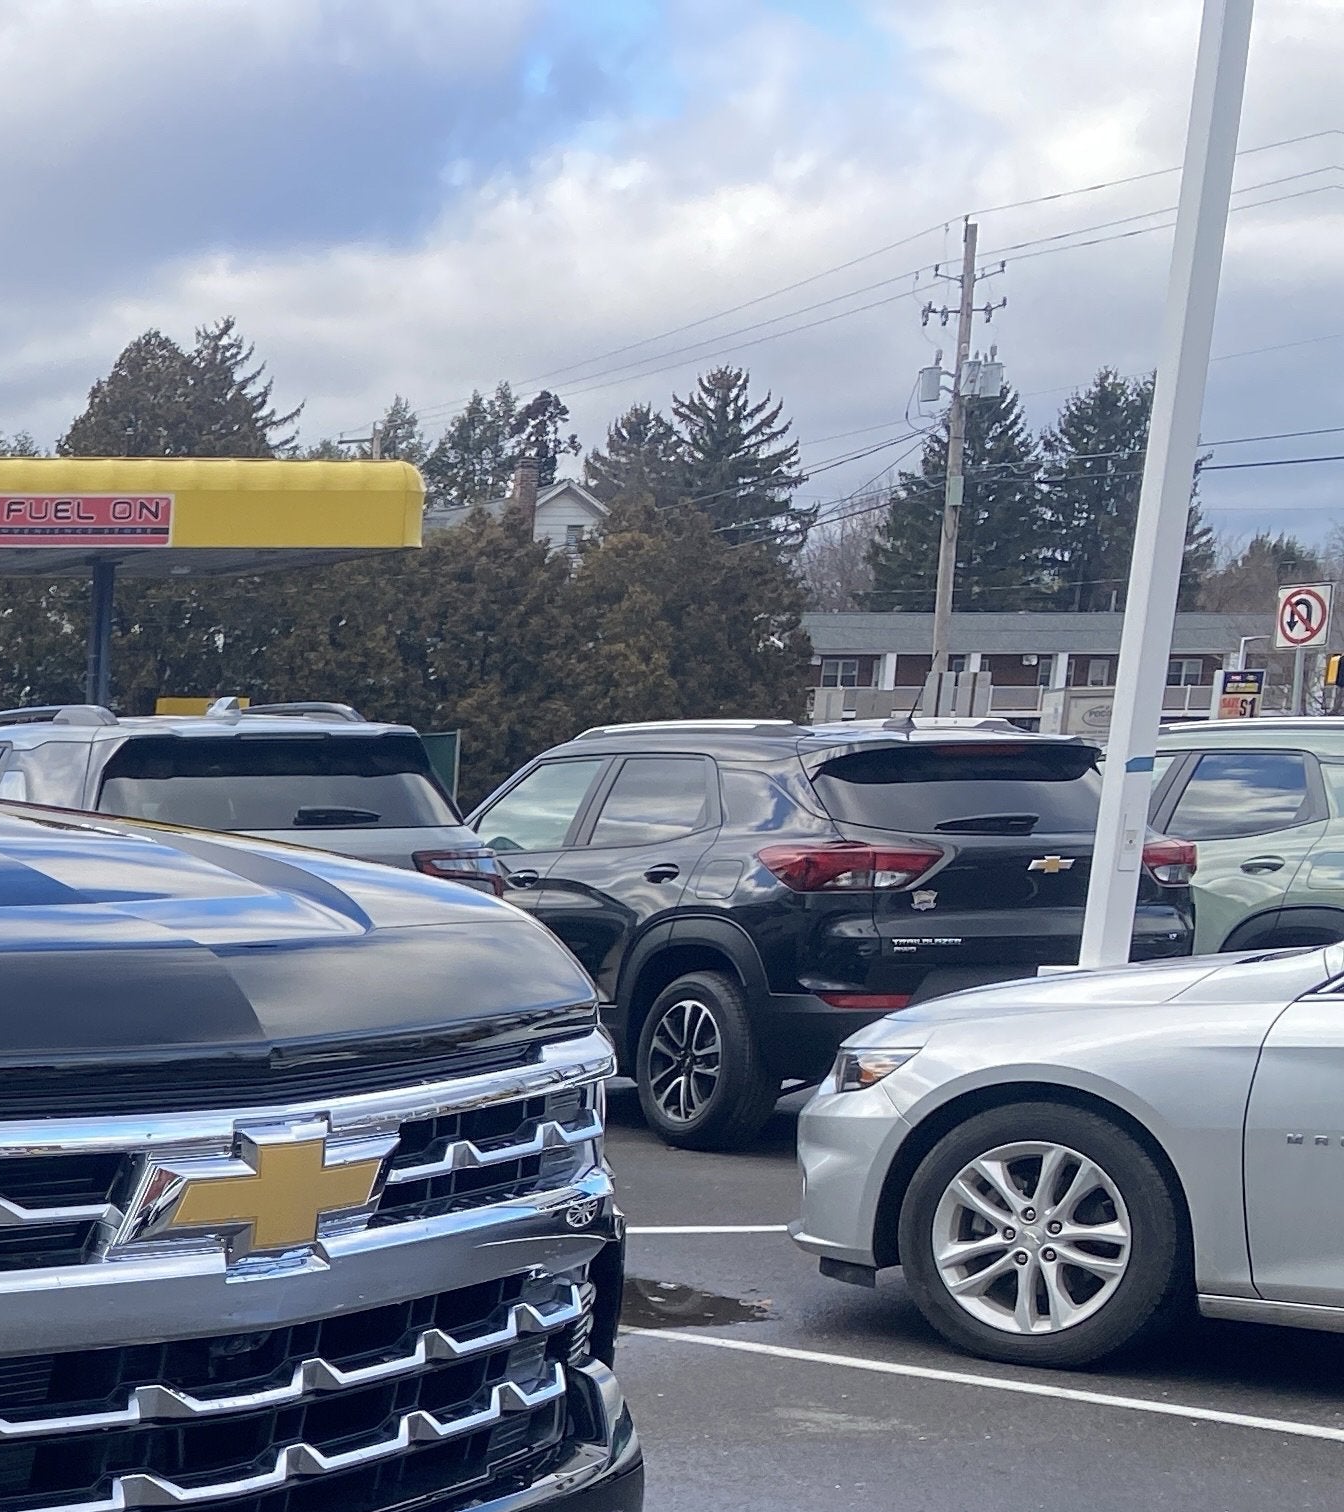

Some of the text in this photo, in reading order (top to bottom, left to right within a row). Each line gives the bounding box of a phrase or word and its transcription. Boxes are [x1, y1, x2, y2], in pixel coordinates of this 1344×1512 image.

[5, 500, 161, 521] FUEL ON
[1286, 1133, 1344, 1147] MA
